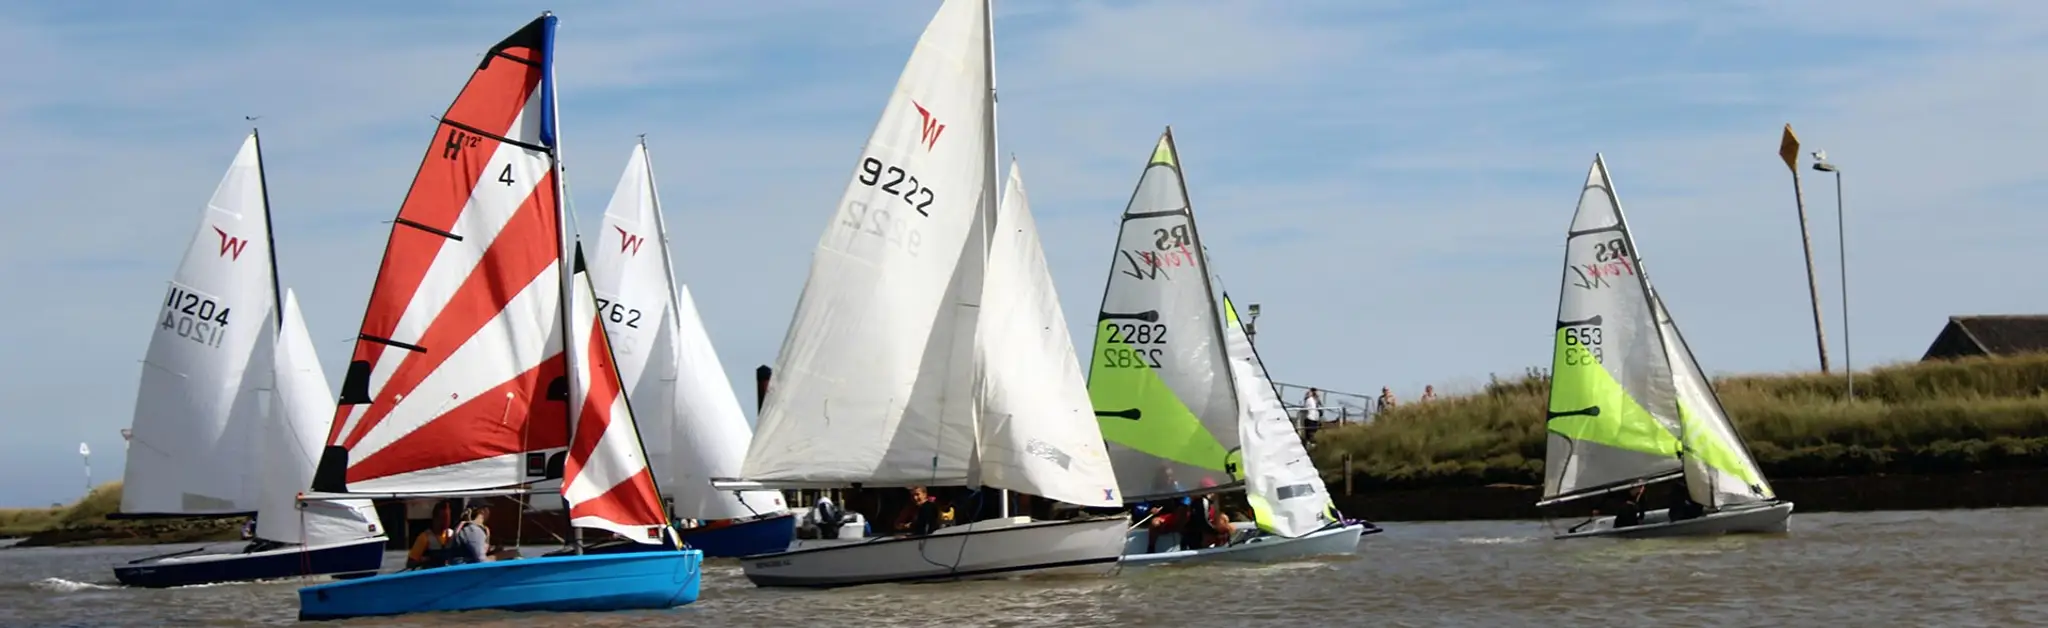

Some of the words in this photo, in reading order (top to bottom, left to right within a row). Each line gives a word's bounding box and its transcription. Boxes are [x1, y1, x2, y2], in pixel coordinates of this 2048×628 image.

[498, 163, 515, 186] 4
[859, 157, 934, 217] 9222
[167, 287, 231, 328] 11204
[1106, 324, 1167, 344] 2282
[1565, 327, 1603, 346] 653
